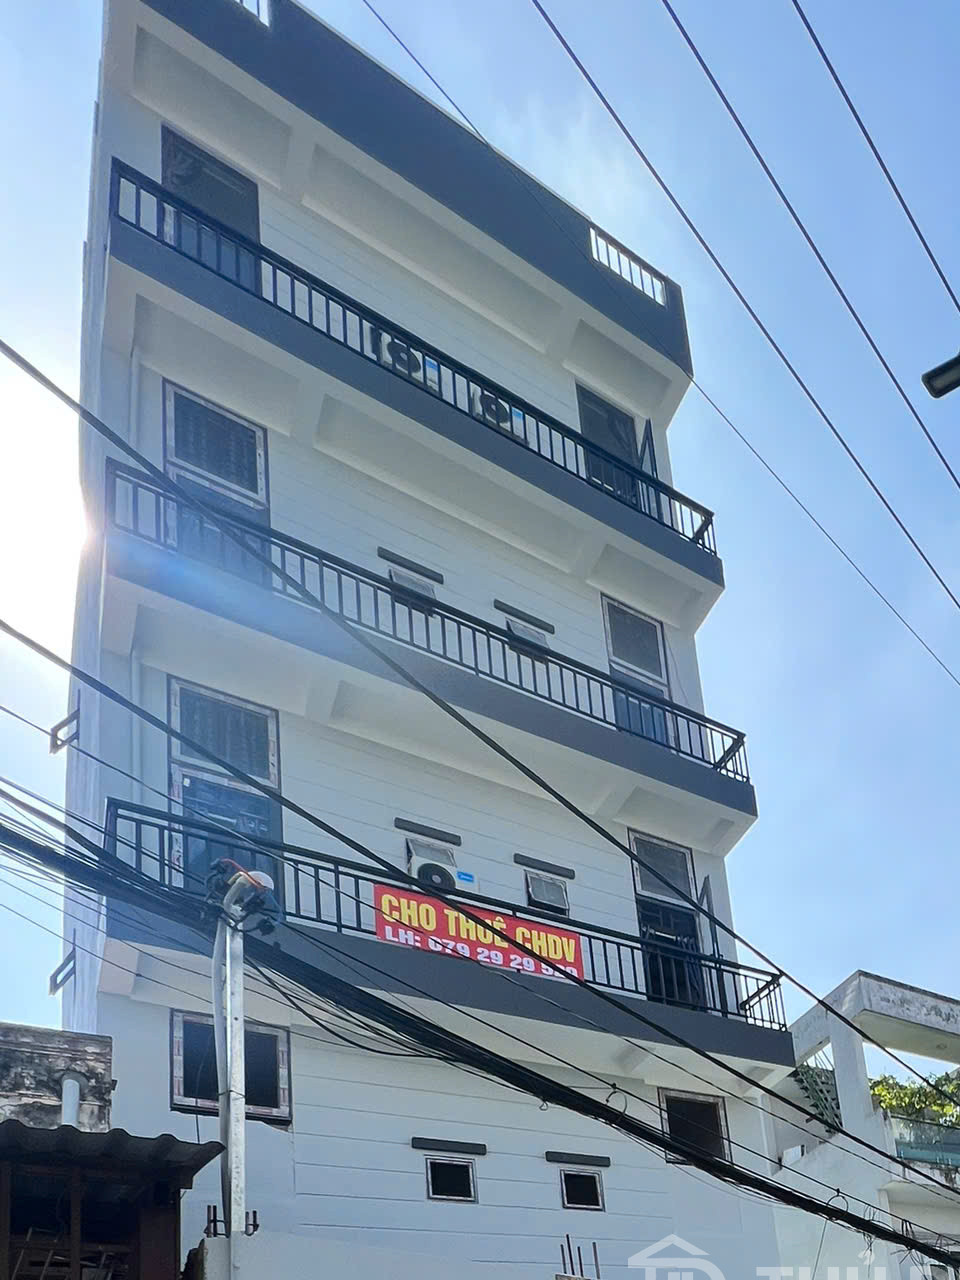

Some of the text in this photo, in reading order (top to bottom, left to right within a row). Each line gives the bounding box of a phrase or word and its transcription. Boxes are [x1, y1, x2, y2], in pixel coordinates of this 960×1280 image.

[380, 893, 576, 964] CHO THUÊ CHDV
[383, 924, 422, 947] LH:
[427, 935, 471, 958] 079
[476, 947, 504, 966] 29
[509, 953, 536, 973] 29
